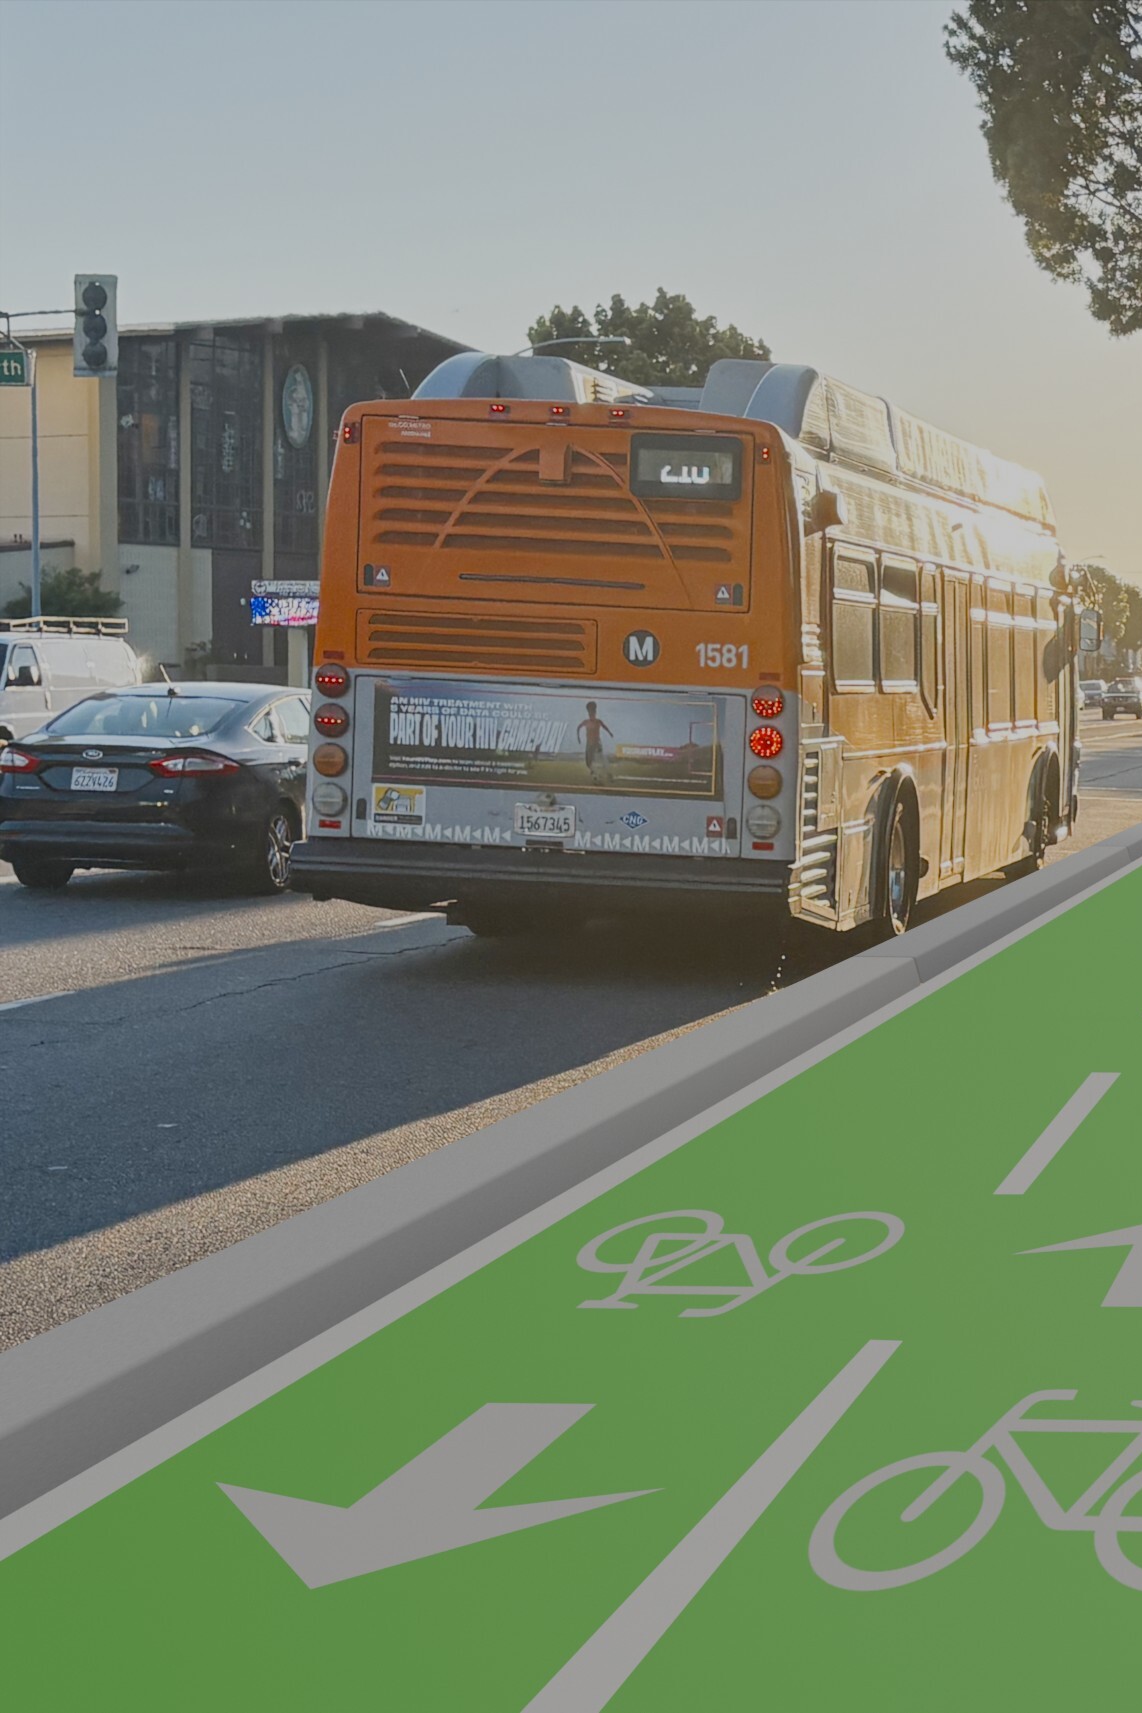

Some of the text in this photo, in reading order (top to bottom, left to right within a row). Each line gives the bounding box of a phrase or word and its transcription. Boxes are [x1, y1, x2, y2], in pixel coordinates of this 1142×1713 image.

[0, 359, 22, 376] th
[629, 635, 654, 661] M
[695, 643, 749, 669] 1581
[391, 696, 533, 711] AN HIV TREATMENT WITH
[400, 705, 439, 714] YEARS
[442, 707, 457, 715] OF
[460, 708, 489, 717] DATA
[492, 710, 531, 719] COULD
[389, 713, 567, 753] PART OF YOUR HIV GAMEPLAY
[519, 815, 571, 833] 1567345
[622, 814, 644, 827] CNG
